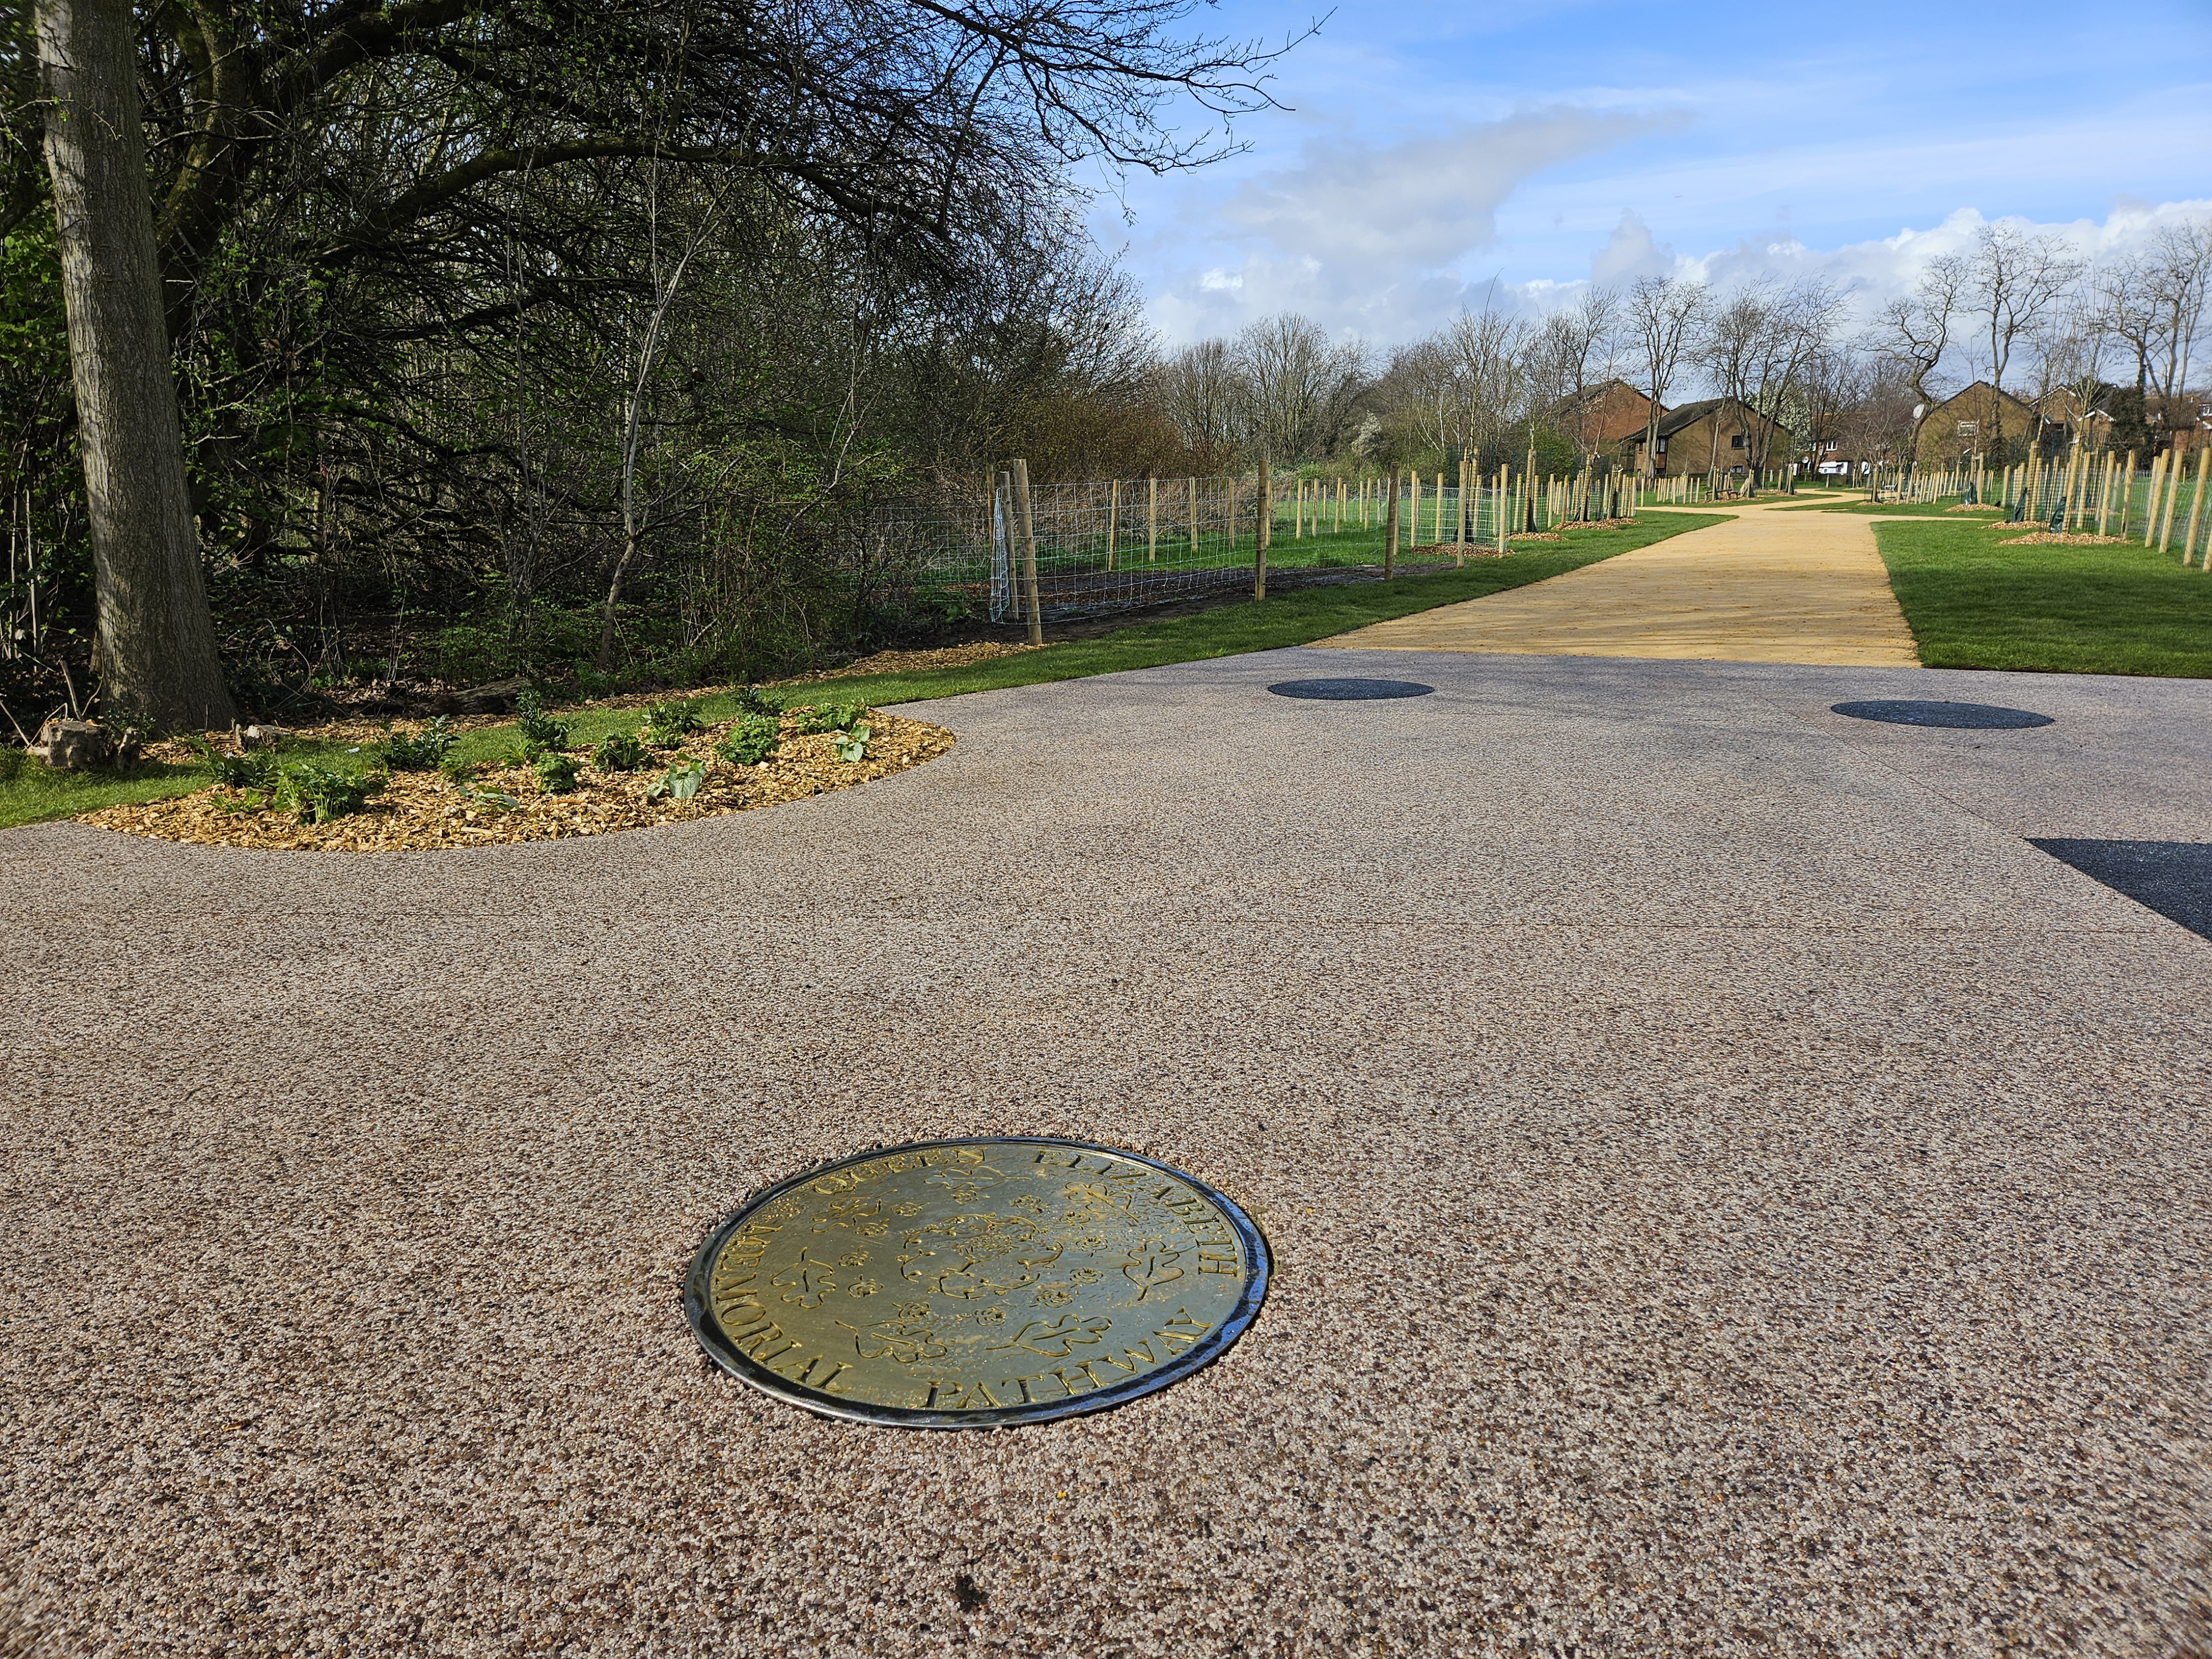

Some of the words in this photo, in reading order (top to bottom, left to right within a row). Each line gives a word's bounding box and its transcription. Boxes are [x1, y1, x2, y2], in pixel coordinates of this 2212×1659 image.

[811, 1146, 987, 1196] QUEEN
[1033, 1149, 1239, 1276] ELIZABETH
[714, 1224, 853, 1394] MEMORIAL
[920, 1307, 1213, 1409] PATHWAY
